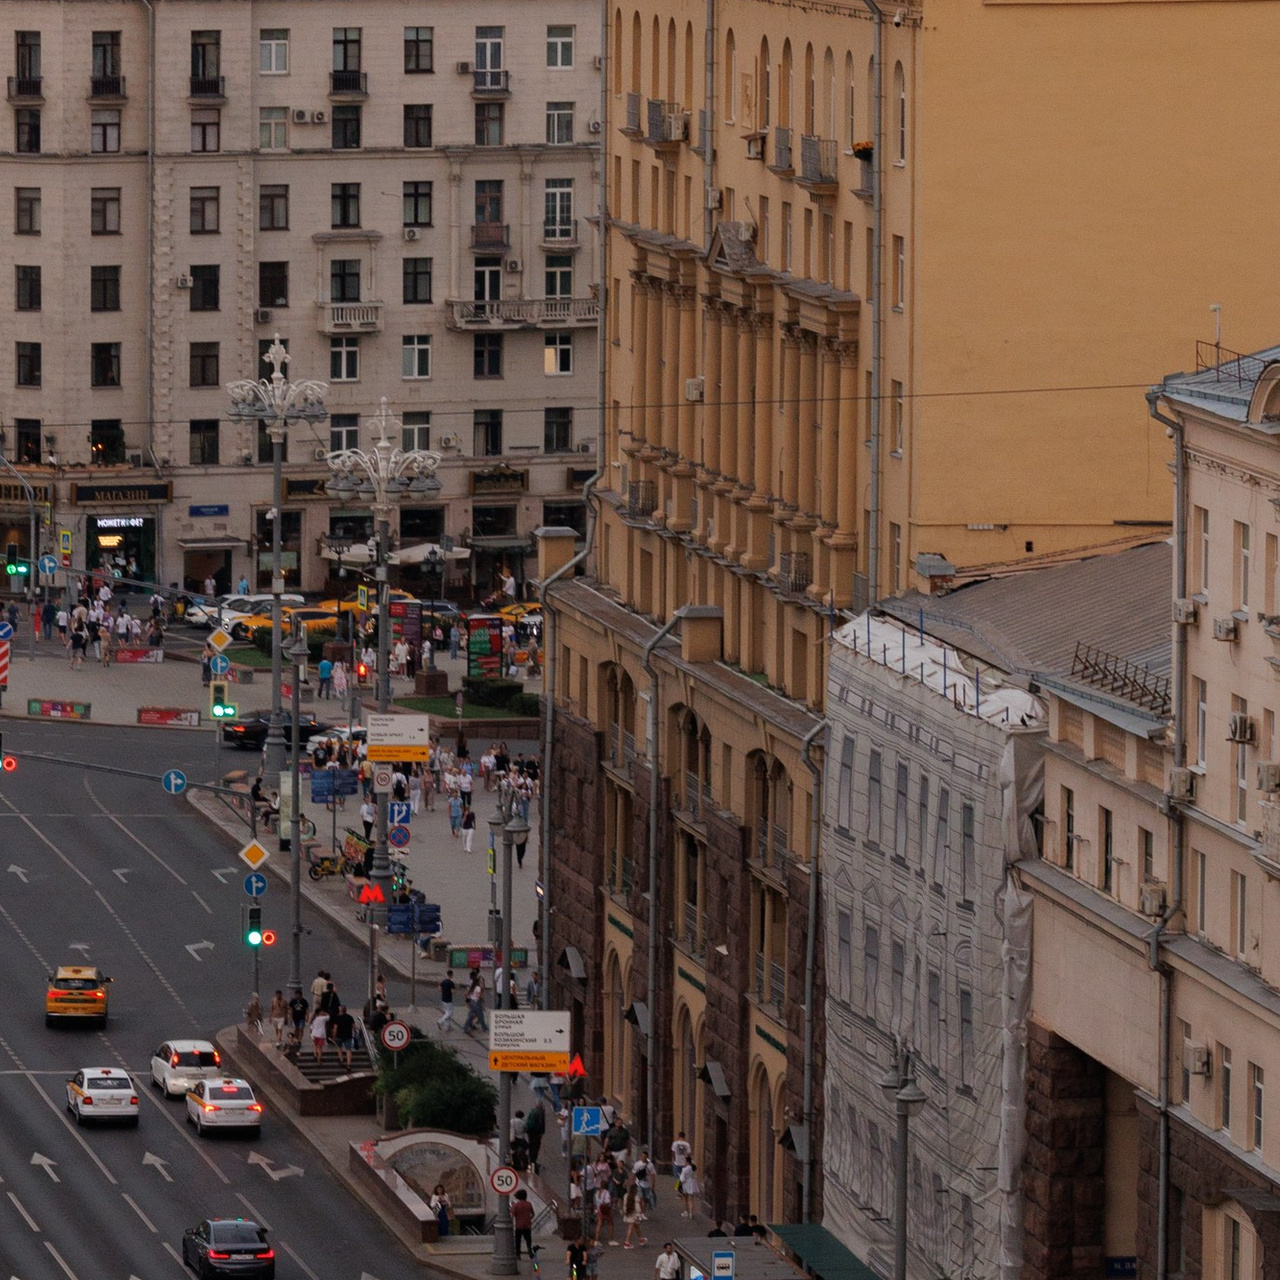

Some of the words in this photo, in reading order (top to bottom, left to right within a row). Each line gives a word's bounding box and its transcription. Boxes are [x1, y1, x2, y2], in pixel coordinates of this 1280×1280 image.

[94, 489, 149, 502] МАГАЗИН
[388, 1030, 404, 1042] 50
[497, 1175, 513, 1187] 50
